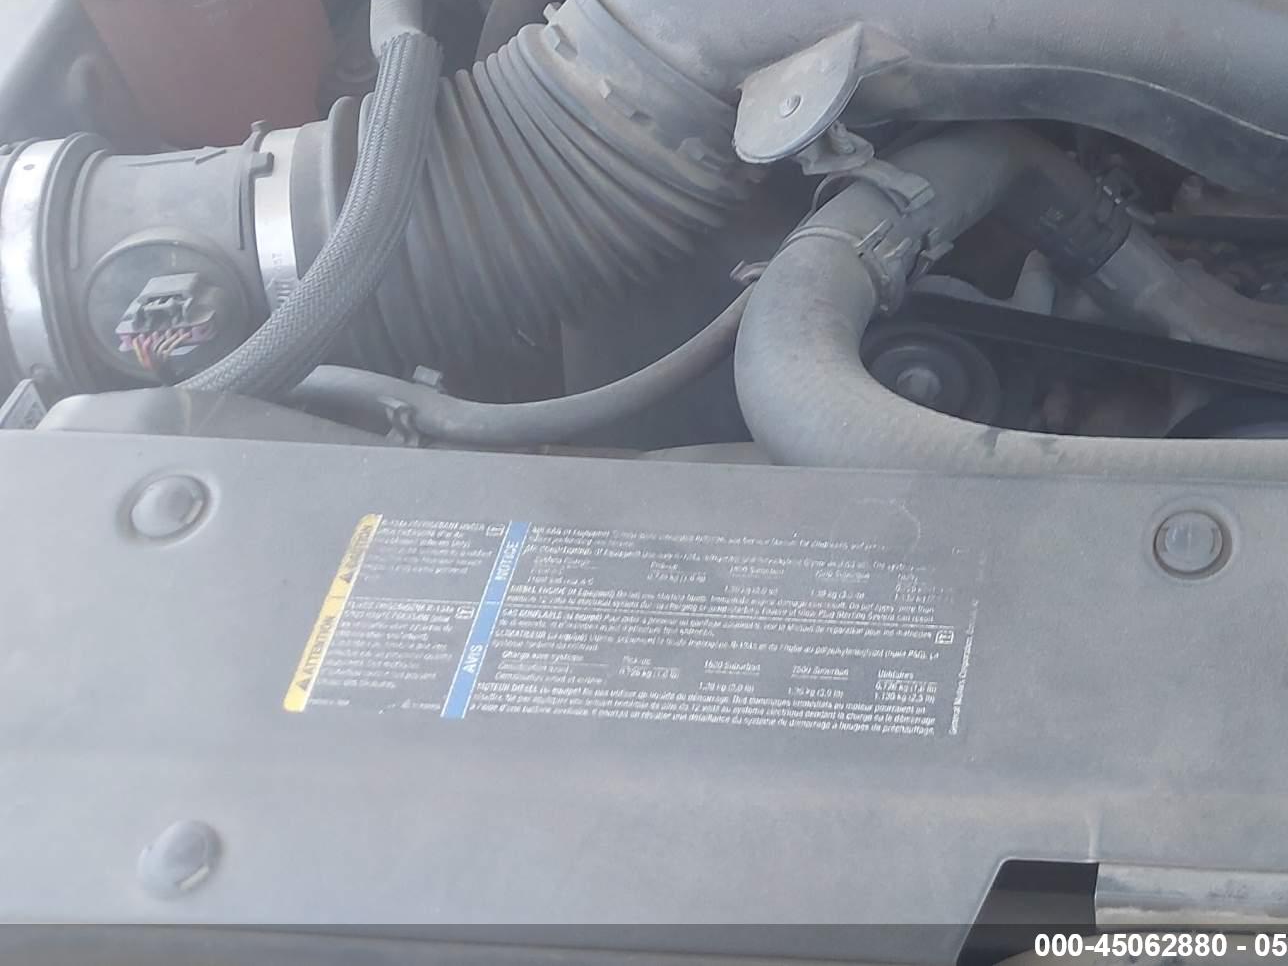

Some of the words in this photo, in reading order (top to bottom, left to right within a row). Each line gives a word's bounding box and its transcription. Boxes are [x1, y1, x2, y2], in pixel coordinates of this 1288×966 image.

[494, 541, 520, 581] NOTICE
[302, 615, 336, 679] ATTENTION
[461, 644, 484, 674] AVIS
